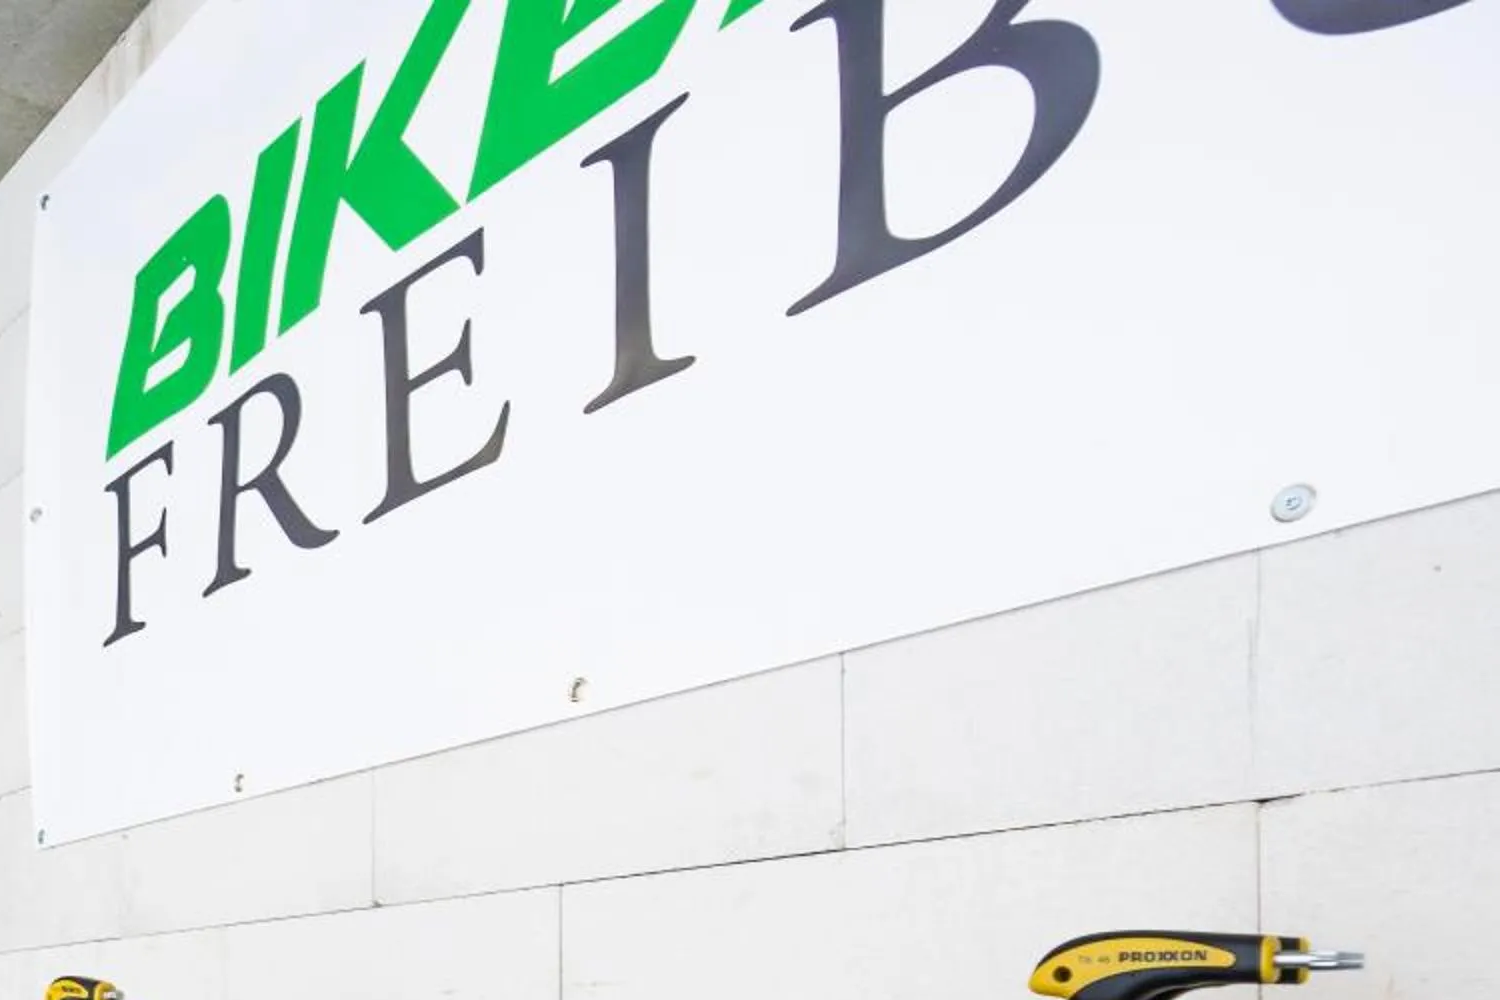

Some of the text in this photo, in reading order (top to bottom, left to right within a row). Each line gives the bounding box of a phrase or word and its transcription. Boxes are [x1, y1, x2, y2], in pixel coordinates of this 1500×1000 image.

[102, 0, 1475, 649] FREIB
[105, 0, 765, 462] BIKE
[1117, 949, 1208, 963] PROXXON
